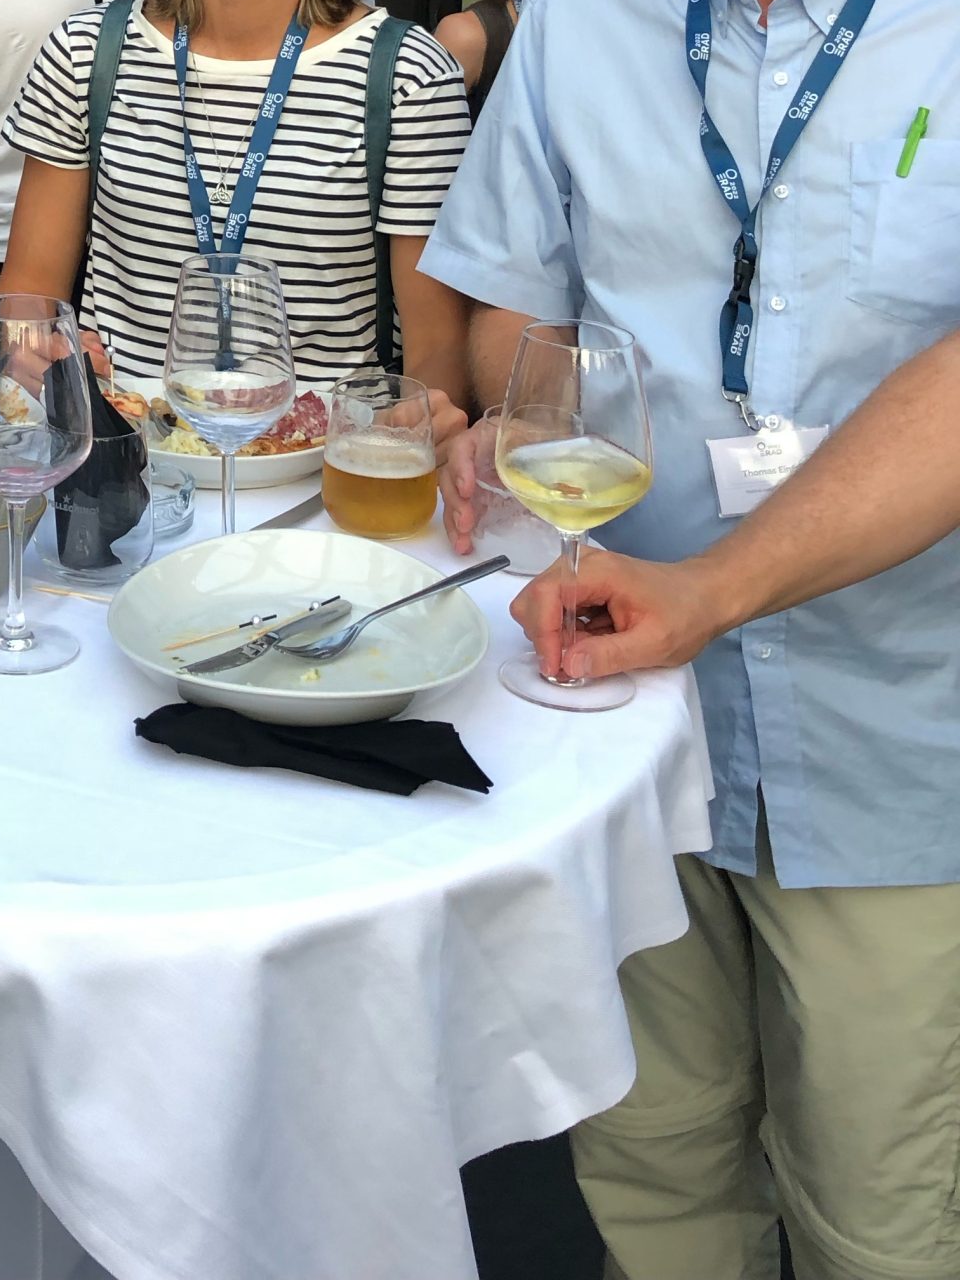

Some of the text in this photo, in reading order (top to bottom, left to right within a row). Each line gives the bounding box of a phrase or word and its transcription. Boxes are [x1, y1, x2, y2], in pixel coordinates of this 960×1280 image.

[280, 33, 295, 58] ERAD
[699, 32, 710, 61] ERAD
[833, 30, 854, 58] ERAD
[834, 26, 847, 43] 2022
[287, 45, 296, 60] 2022
[261, 92, 276, 118] ERAD
[268, 103, 277, 119] 2022
[798, 90, 811, 107] 2022
[798, 93, 819, 121] ERAD
[242, 152, 257, 177] ERAD
[248, 163, 257, 178] 2022
[716, 172, 734, 200] ERAD
[729, 181, 739, 200] 2022
[194, 216, 205, 242] ERAD
[225, 212, 238, 239] ERAD
[730, 323, 744, 354] ERAD
[743, 468, 777, 477] Thomas
